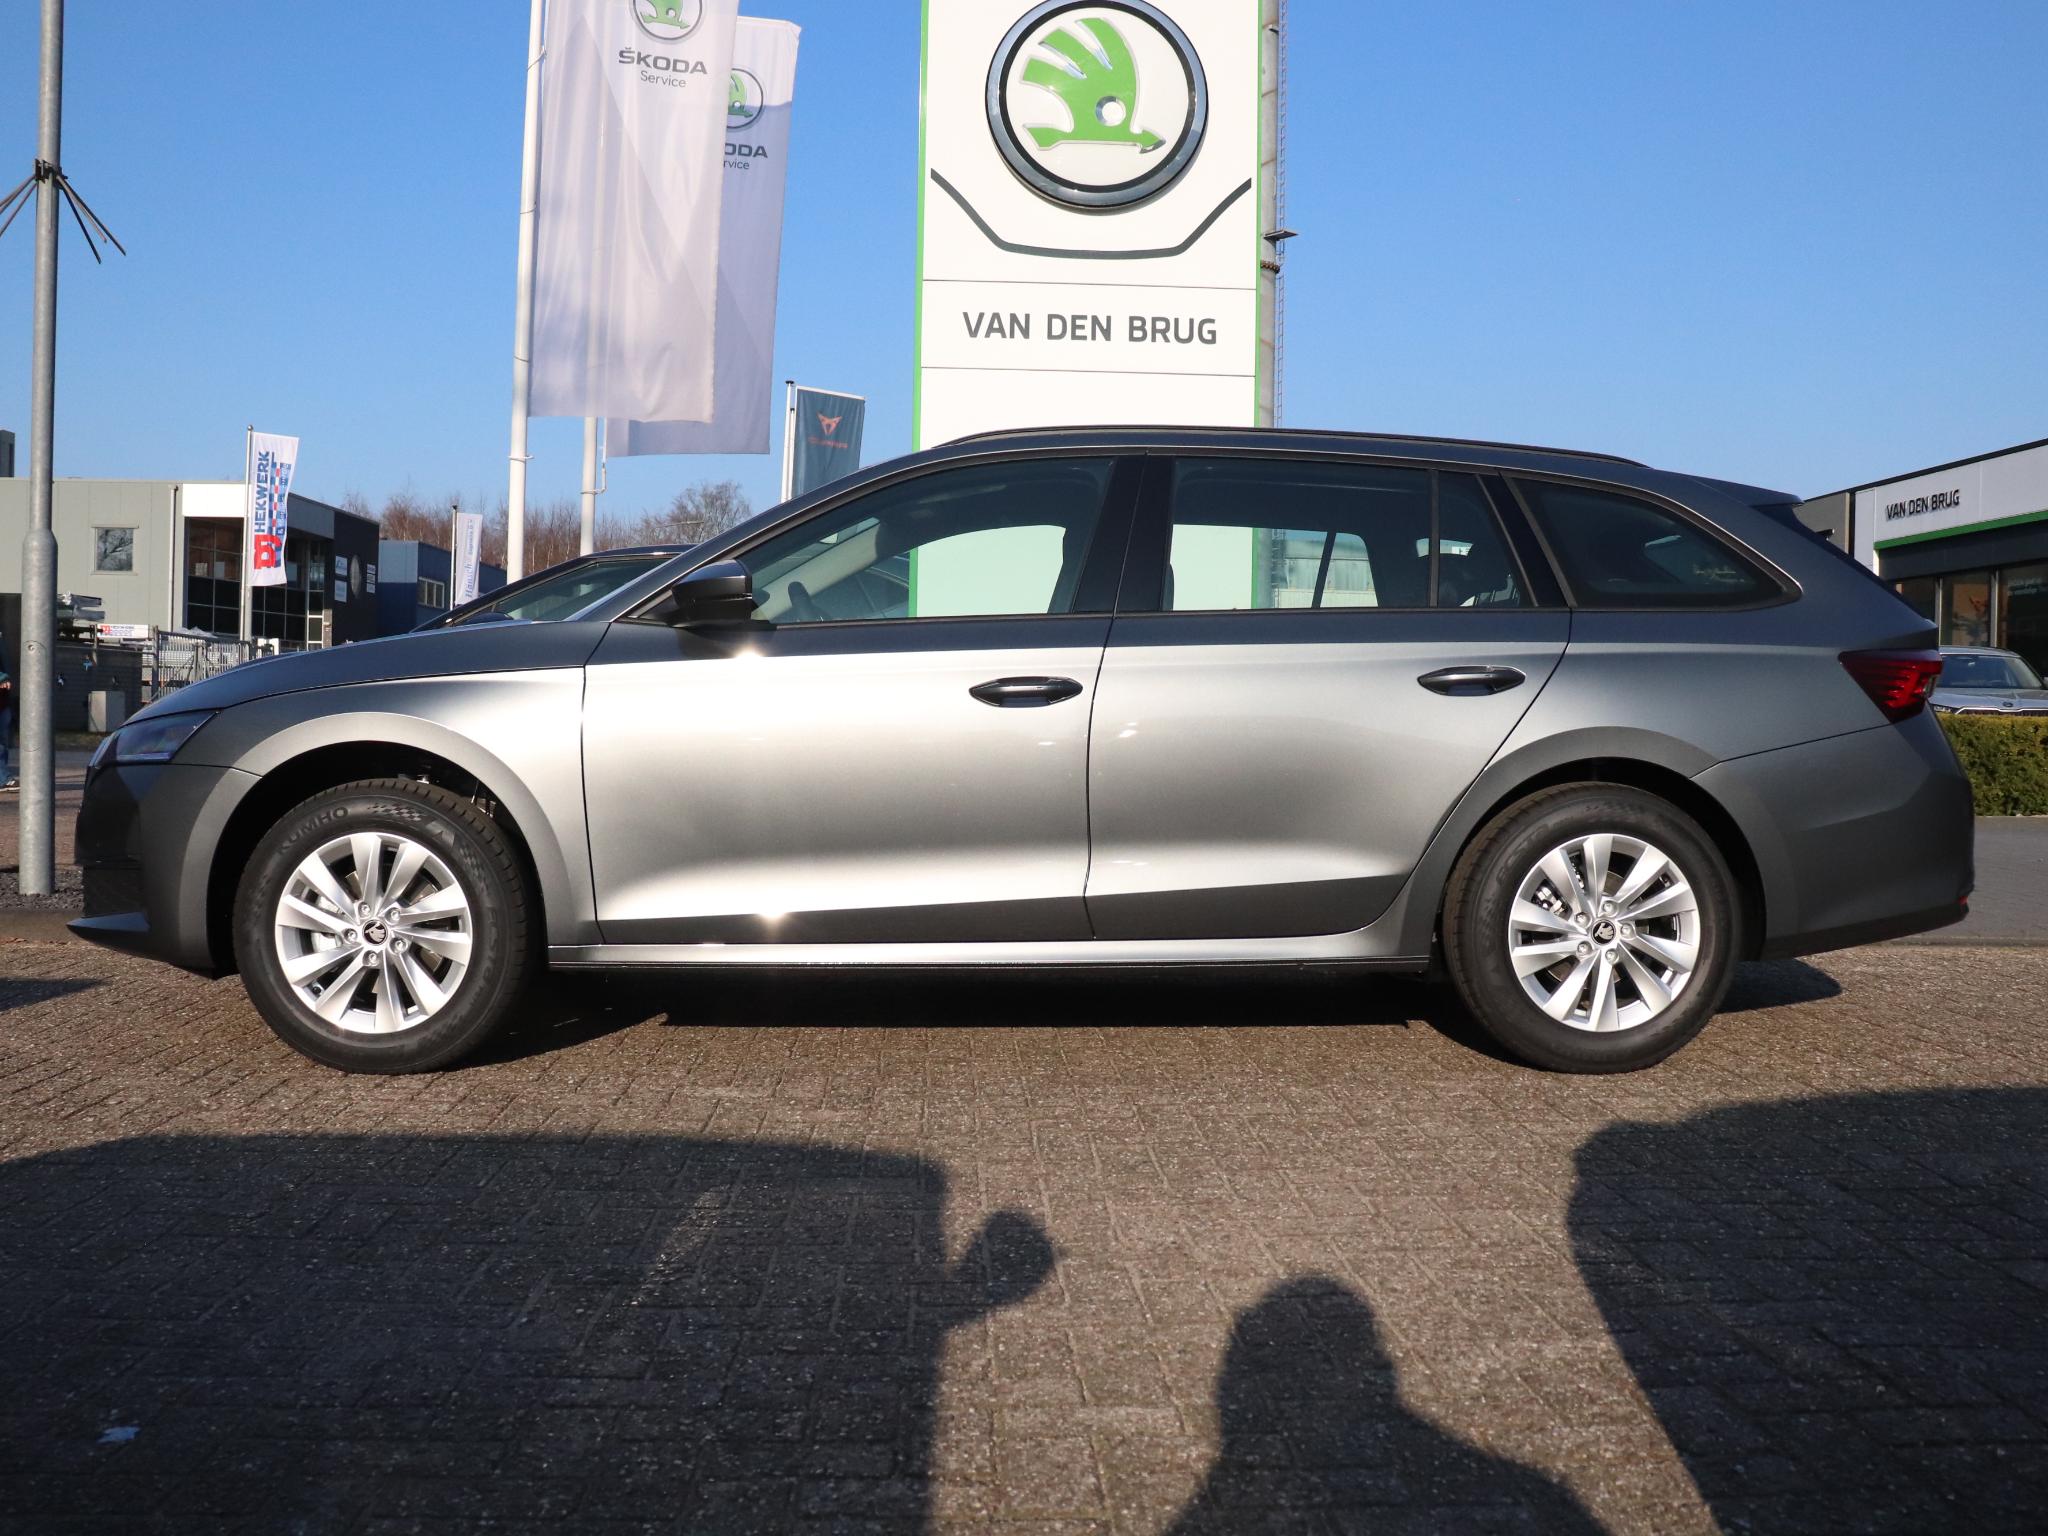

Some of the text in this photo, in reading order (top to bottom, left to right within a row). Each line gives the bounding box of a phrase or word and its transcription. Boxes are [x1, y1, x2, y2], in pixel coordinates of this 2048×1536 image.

[618, 47, 708, 75] ŠKODA
[640, 71, 686, 88] Service
[723, 160, 749, 170] rvice
[725, 143, 768, 158] ODA
[962, 311, 1217, 345] VAN DEN BRUG
[254, 451, 270, 533] HEKWERK
[1886, 489, 1960, 520] VAN DEN BRUG
[280, 806, 348, 854] KUMHO
